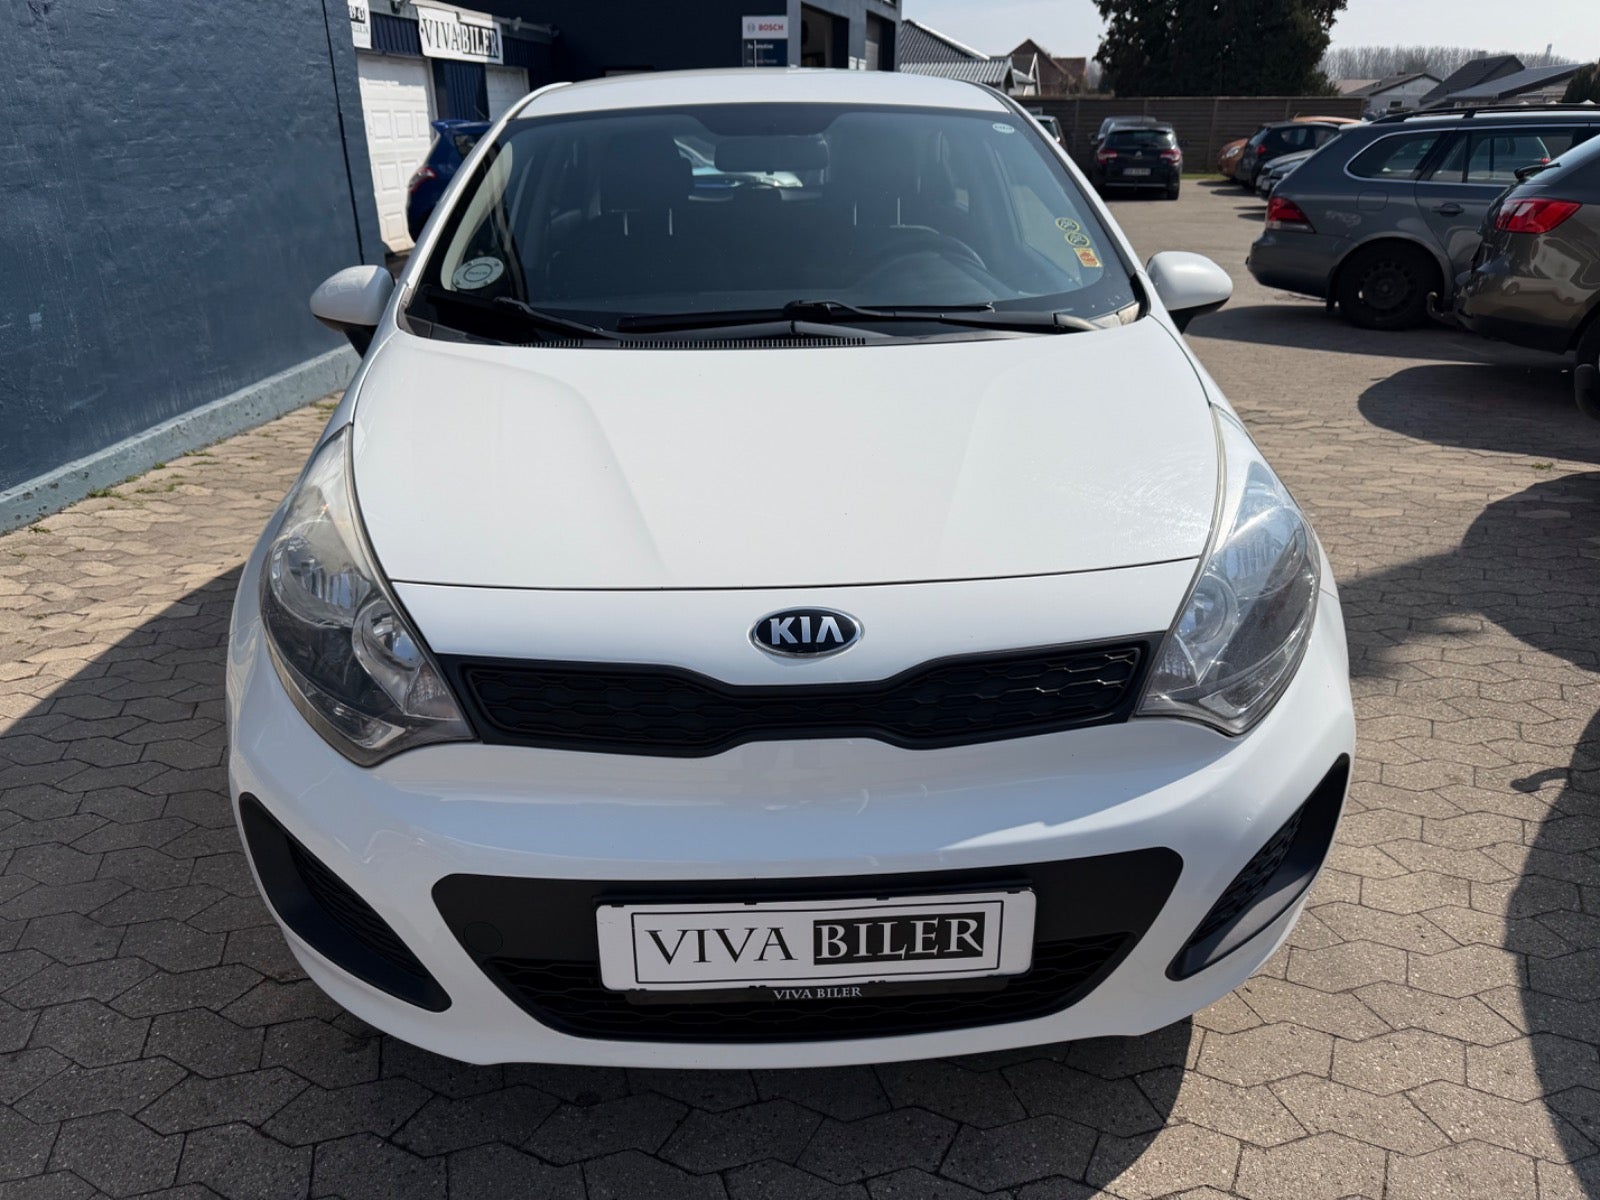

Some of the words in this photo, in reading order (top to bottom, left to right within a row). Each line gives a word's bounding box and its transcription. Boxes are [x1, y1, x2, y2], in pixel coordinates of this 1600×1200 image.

[422, 18, 460, 51] VIVA
[461, 24, 499, 57] BILER
[758, 23, 784, 31] BOSCH
[769, 616, 844, 645] KIA
[644, 927, 798, 965] VIVA
[815, 917, 983, 960] BILER
[773, 988, 812, 1000] VIVA
[816, 986, 863, 999] BILER
